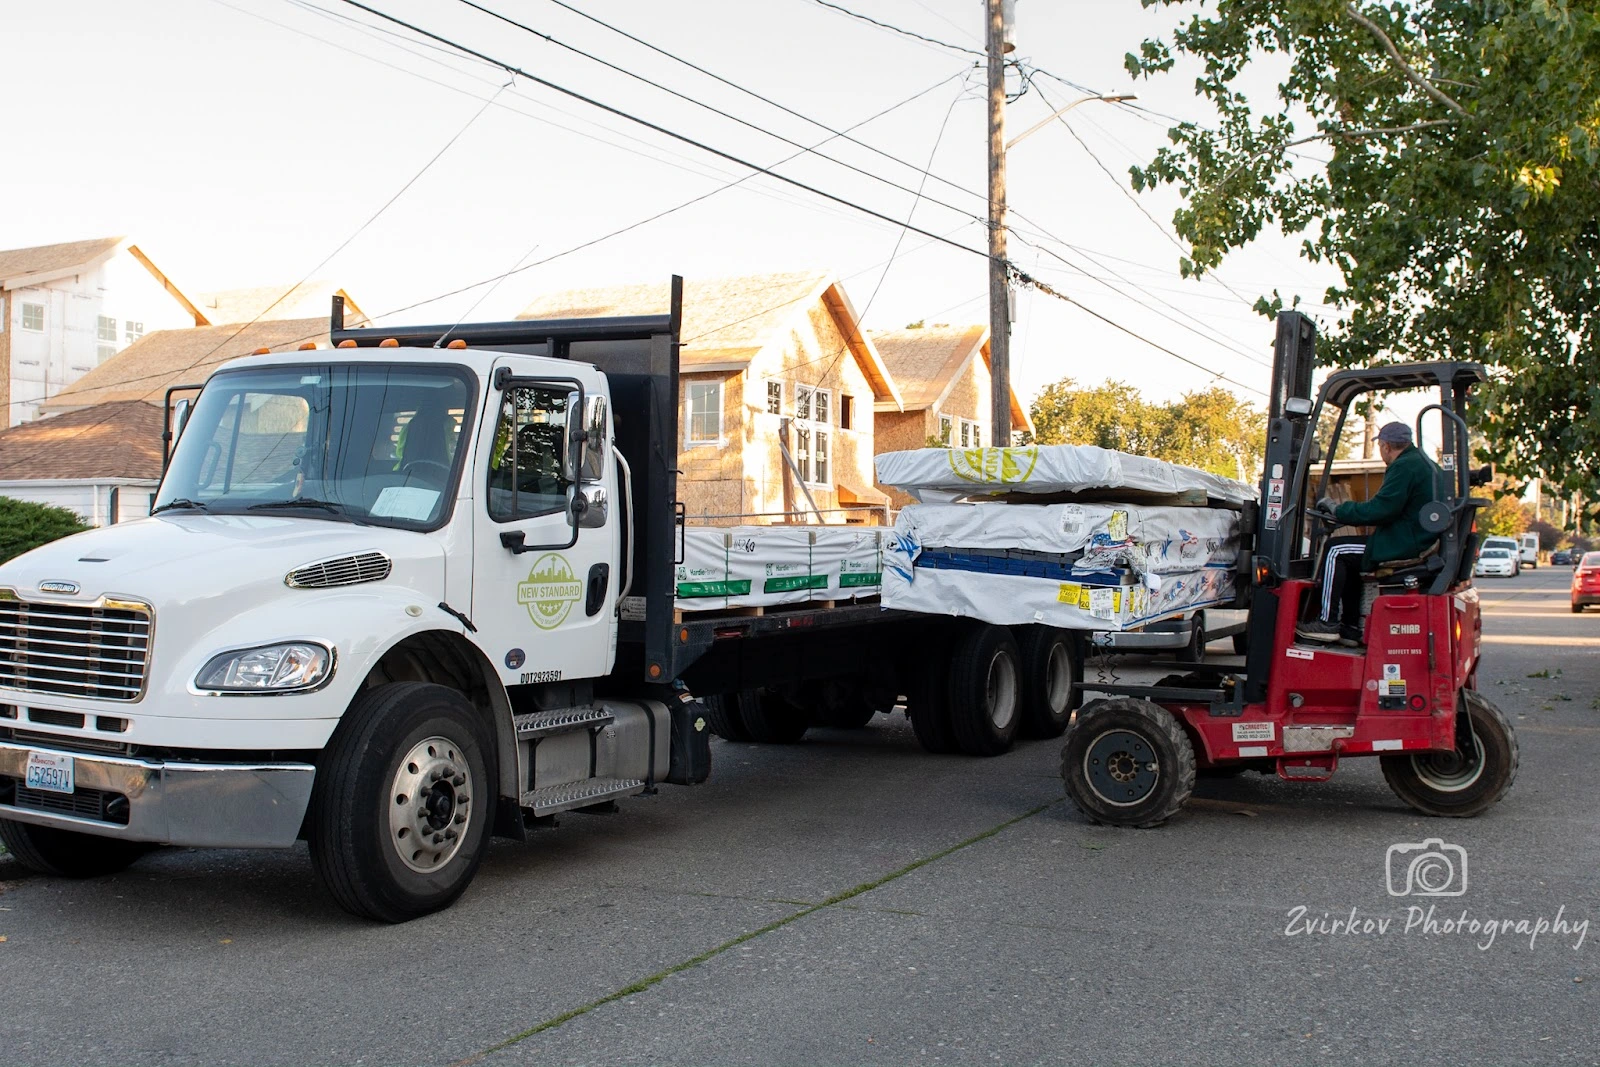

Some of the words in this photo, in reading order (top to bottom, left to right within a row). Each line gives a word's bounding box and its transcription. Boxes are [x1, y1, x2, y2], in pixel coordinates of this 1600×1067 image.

[520, 586, 539, 599] NEW
[540, 585, 580, 598] STANDARD
[1401, 624, 1421, 634] HIAB
[520, 669, 562, 684] DOT2923591
[28, 765, 70, 788] C52597V
